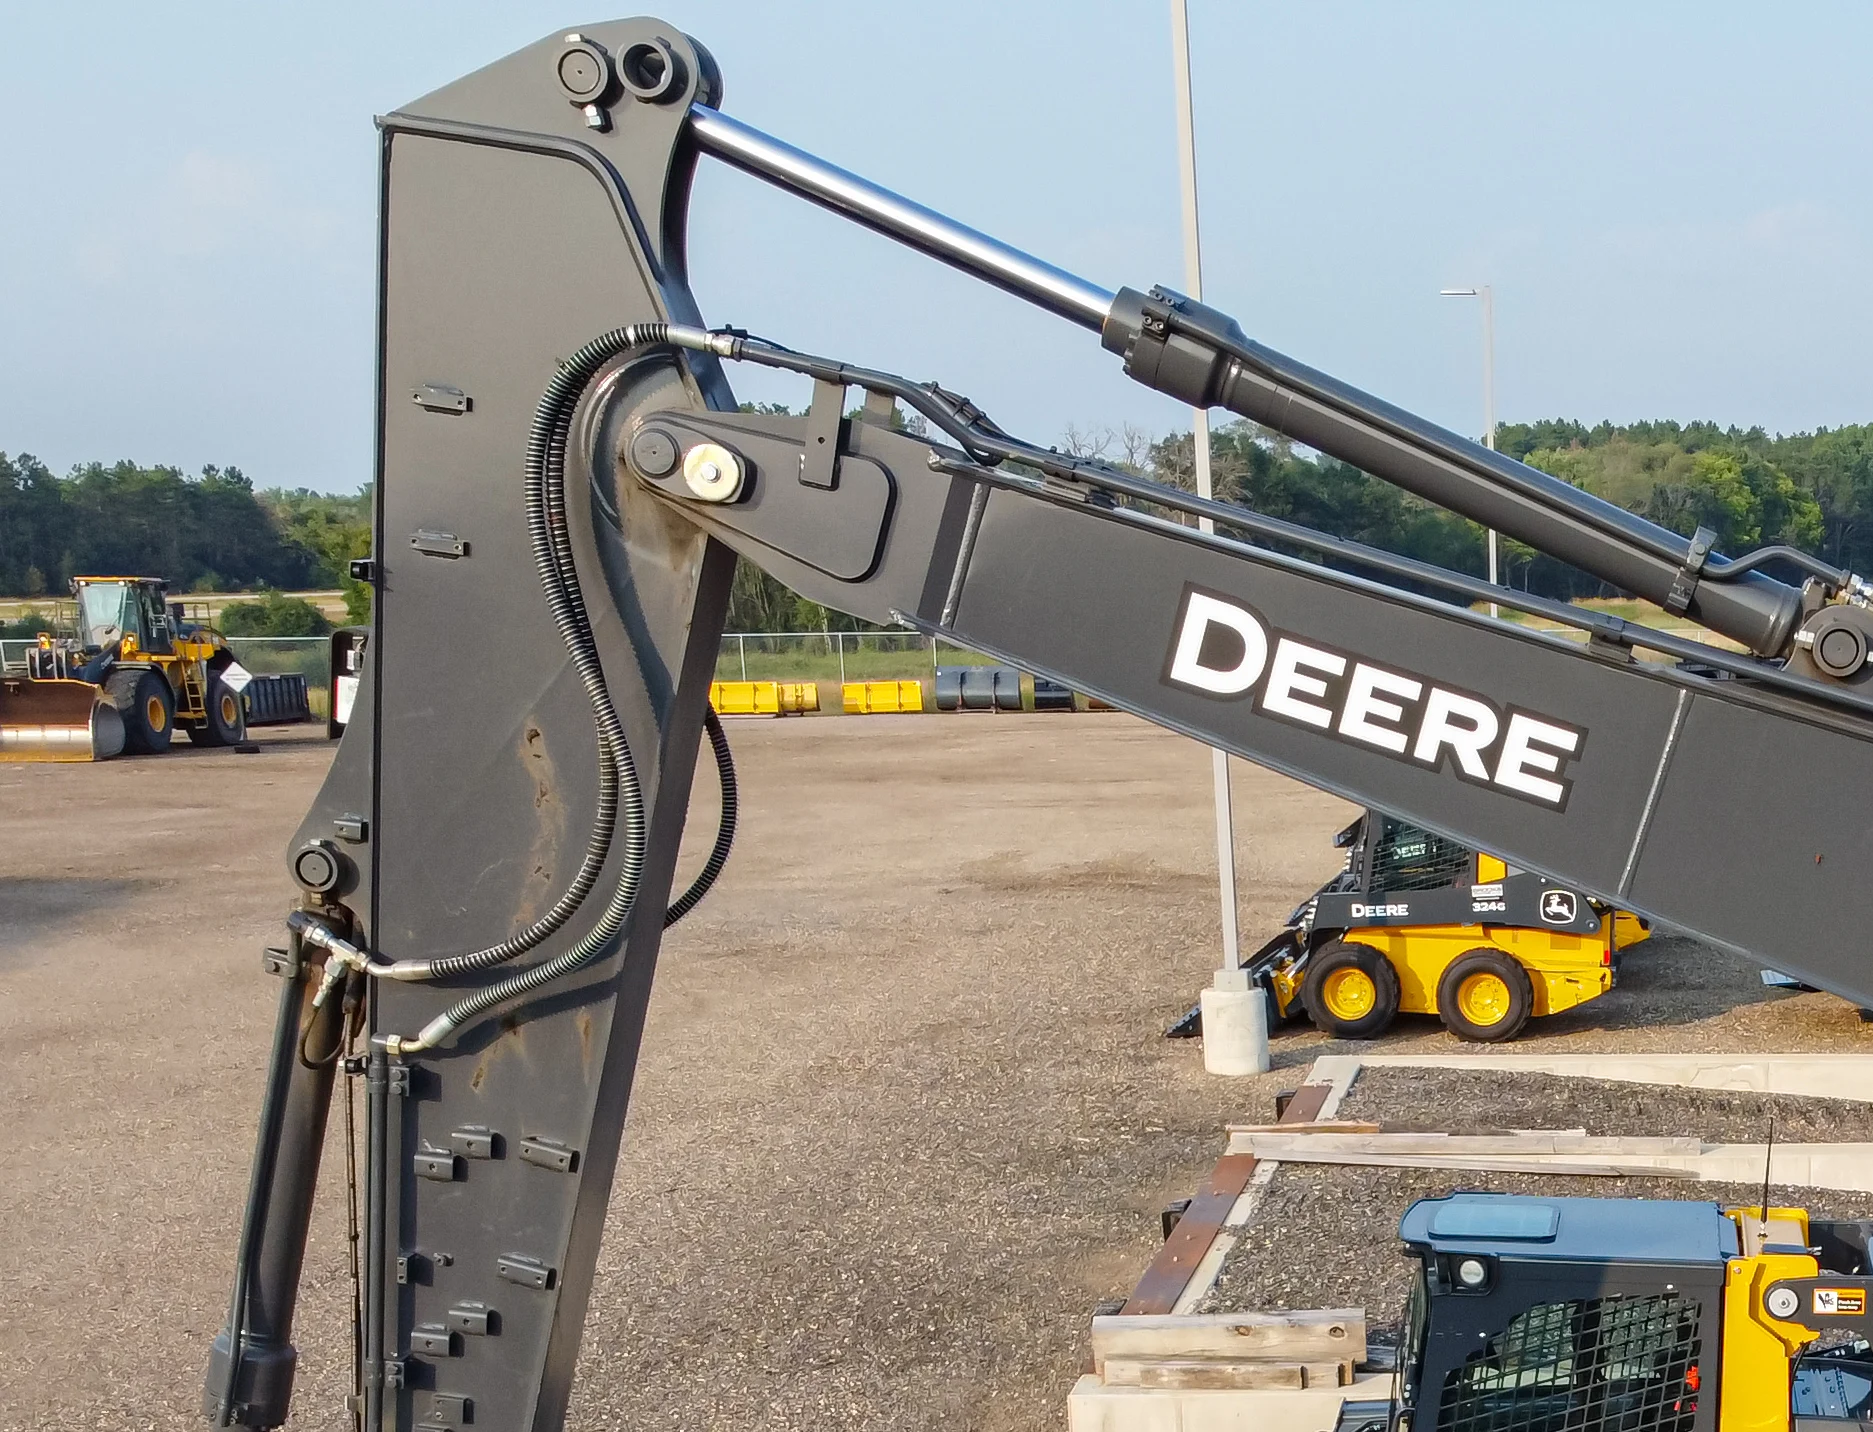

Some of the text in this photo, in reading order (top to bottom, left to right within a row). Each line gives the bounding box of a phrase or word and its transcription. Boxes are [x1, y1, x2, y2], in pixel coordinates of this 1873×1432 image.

[1169, 592, 1580, 803] DEERE
[1351, 903, 1409, 918] DEERE
[1472, 902, 1506, 912] 324G
